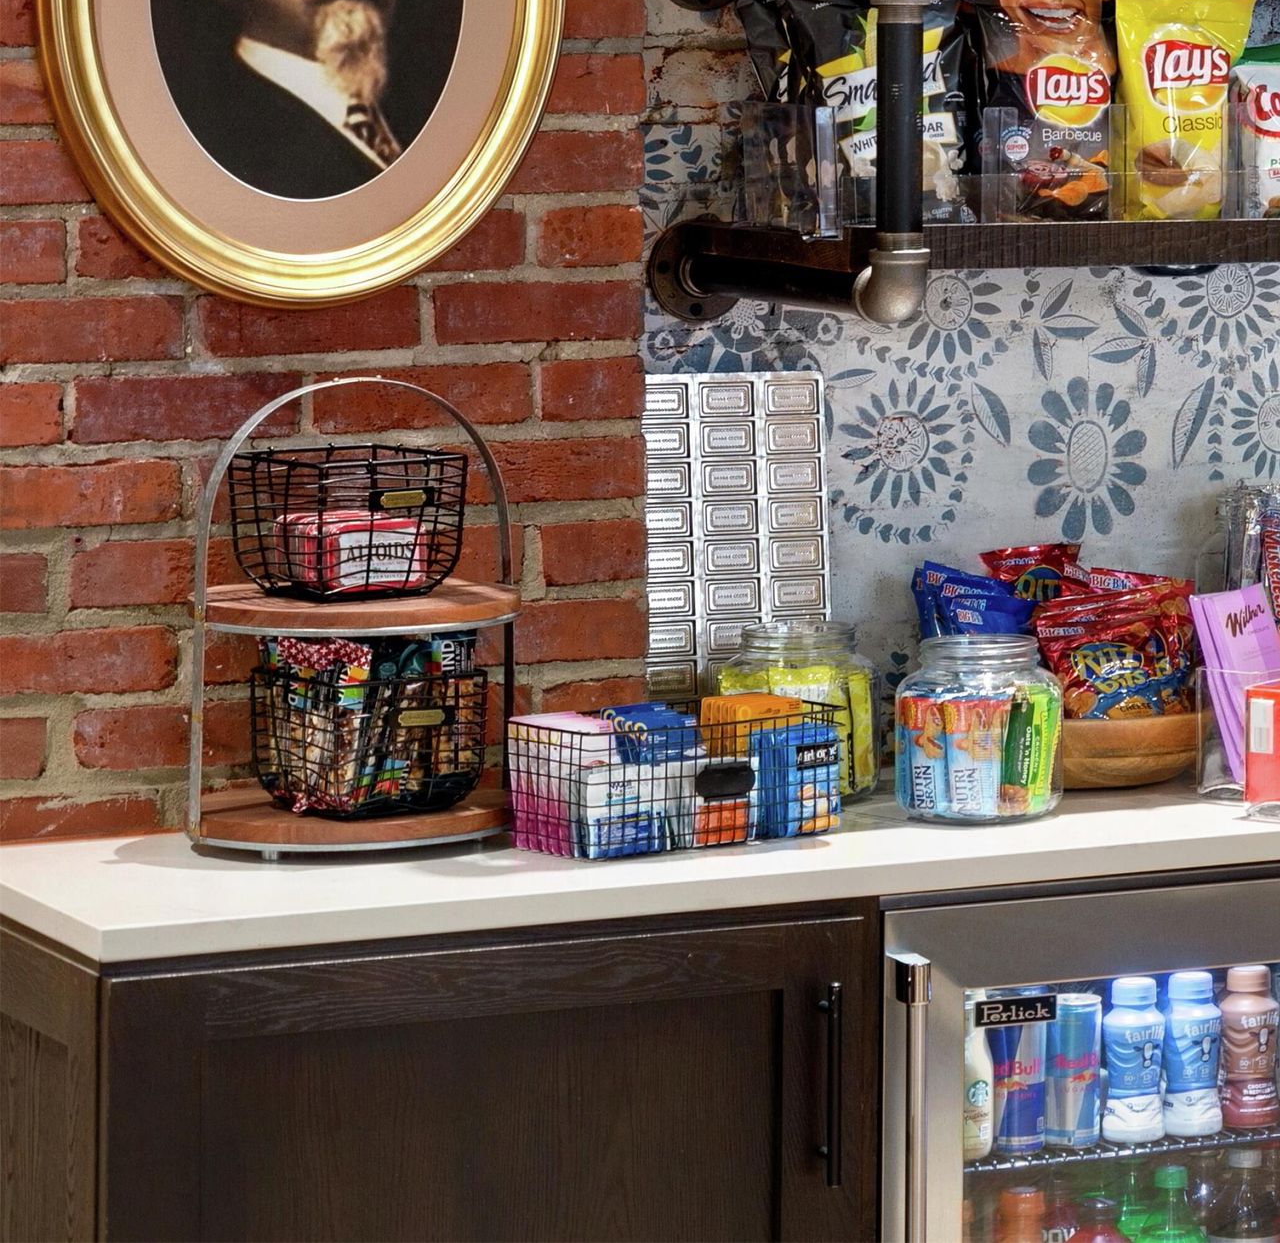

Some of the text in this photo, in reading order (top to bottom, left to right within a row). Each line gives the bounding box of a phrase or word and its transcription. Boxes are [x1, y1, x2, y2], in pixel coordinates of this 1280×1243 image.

[1152, 40, 1230, 88] Lay's
[1036, 69, 1105, 108] Lay's
[1041, 128, 1103, 142] Barbecue
[1162, 113, 1223, 134] Classic
[943, 583, 960, 597] BIG
[1091, 574, 1110, 588] BIG
[1038, 626, 1084, 638] BIG BAG
[1225, 603, 1266, 638] Wilbur
[1078, 646, 1140, 680] RITZ
[1095, 670, 1146, 694] bits
[1019, 758, 1030, 785] Honey
[913, 764, 927, 810] NUTRI
[921, 764, 936, 811] GRAIN
[953, 769, 970, 815] NUTRI
[965, 767, 982, 813] GRAIN
[981, 1002, 1051, 1023] Perlick
[1012, 1058, 1041, 1076] Bull
